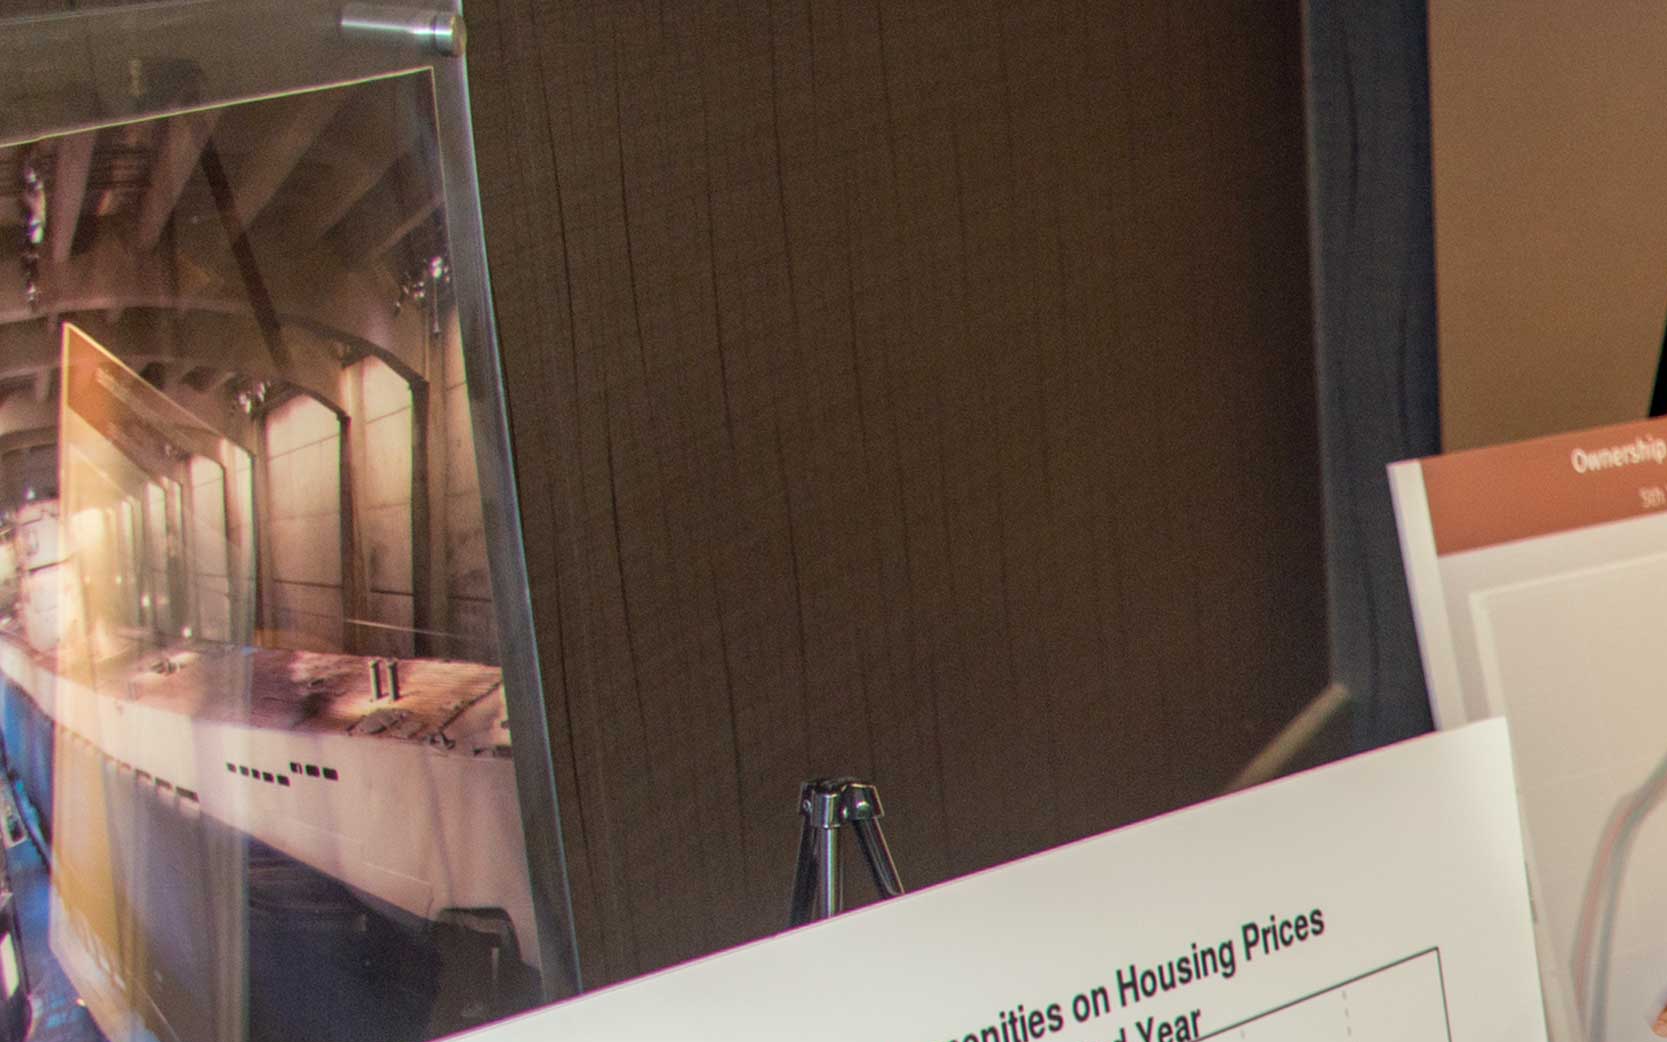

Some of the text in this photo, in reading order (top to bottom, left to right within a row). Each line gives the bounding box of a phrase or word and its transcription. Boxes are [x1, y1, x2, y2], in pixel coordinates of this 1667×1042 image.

[1571, 435, 1667, 473] Ownership
[1073, 984, 1110, 1021] on
[1116, 940, 1235, 1007] Housing
[1241, 906, 1325, 961] Prices
